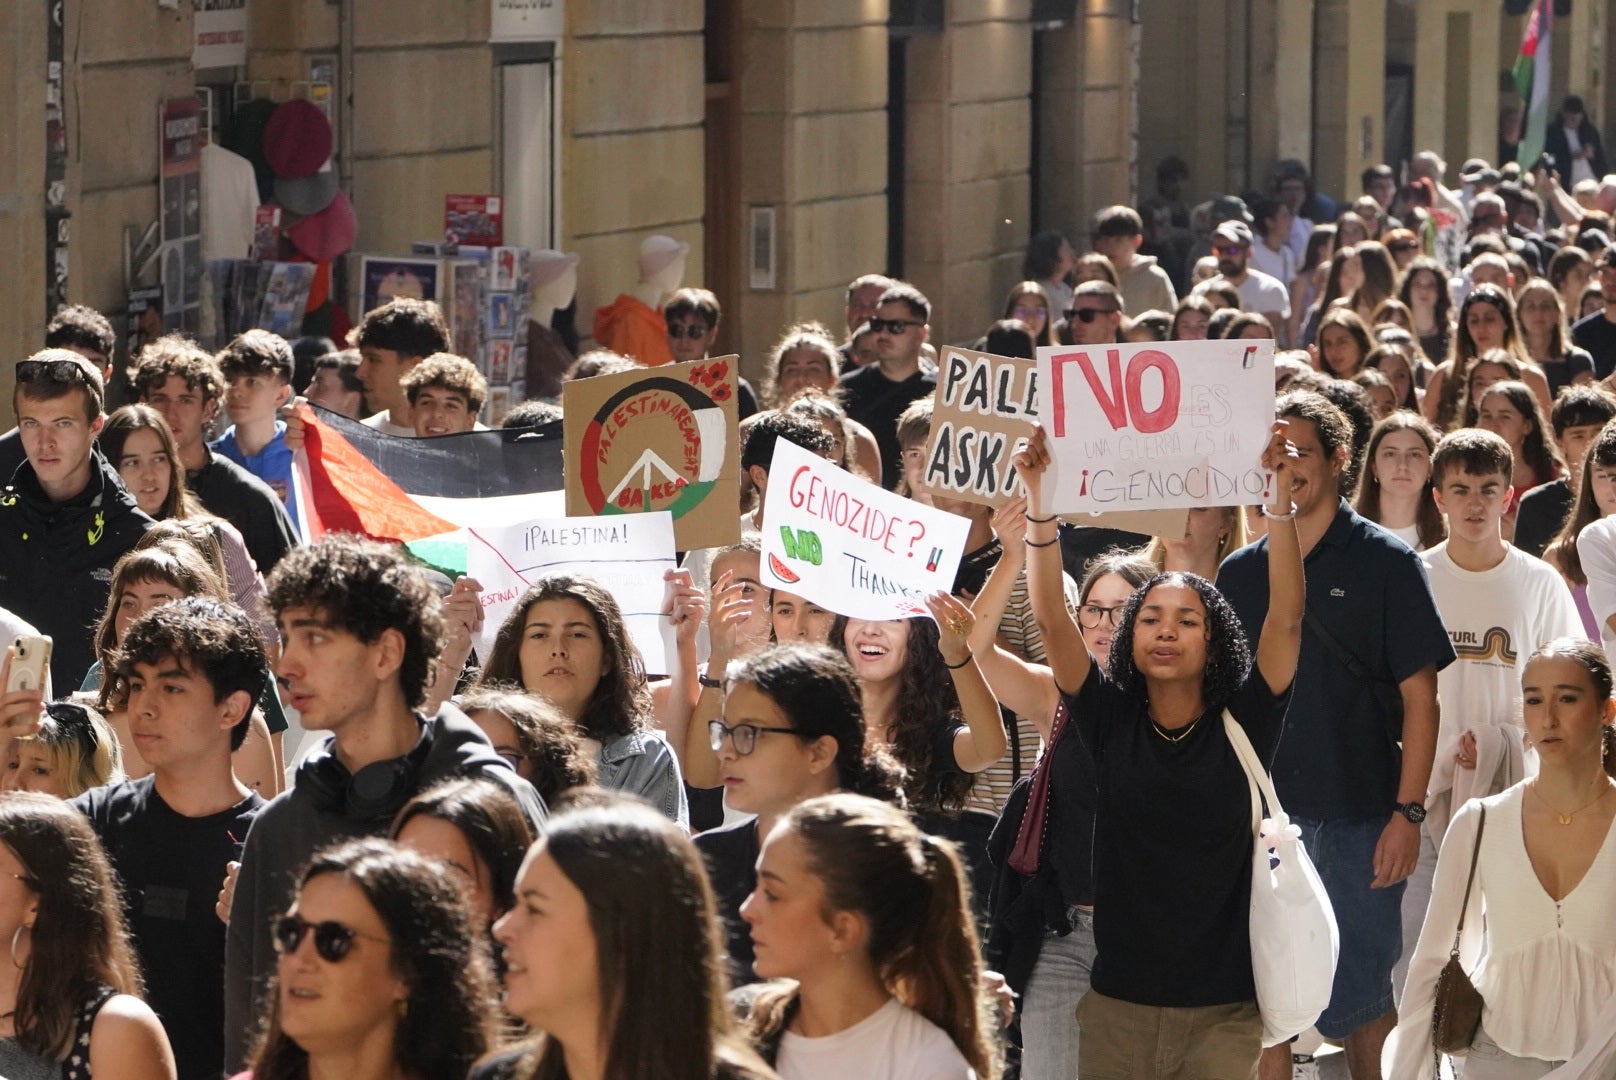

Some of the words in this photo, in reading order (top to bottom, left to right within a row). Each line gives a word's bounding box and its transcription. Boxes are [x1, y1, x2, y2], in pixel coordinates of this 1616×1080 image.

[1050, 348, 1181, 438] NO
[1190, 383, 1232, 429] ES
[1084, 439, 1111, 459] UNA
[1118, 431, 1182, 461] GUERRA
[1223, 431, 1240, 454] UN
[618, 477, 688, 508] BAKEA
[1079, 466, 1273, 503] ¡GENOCIDIO!
[789, 465, 926, 559] GENOZIDE?
[524, 523, 629, 552] ¡PALESTINA!
[779, 525, 824, 567] NO
